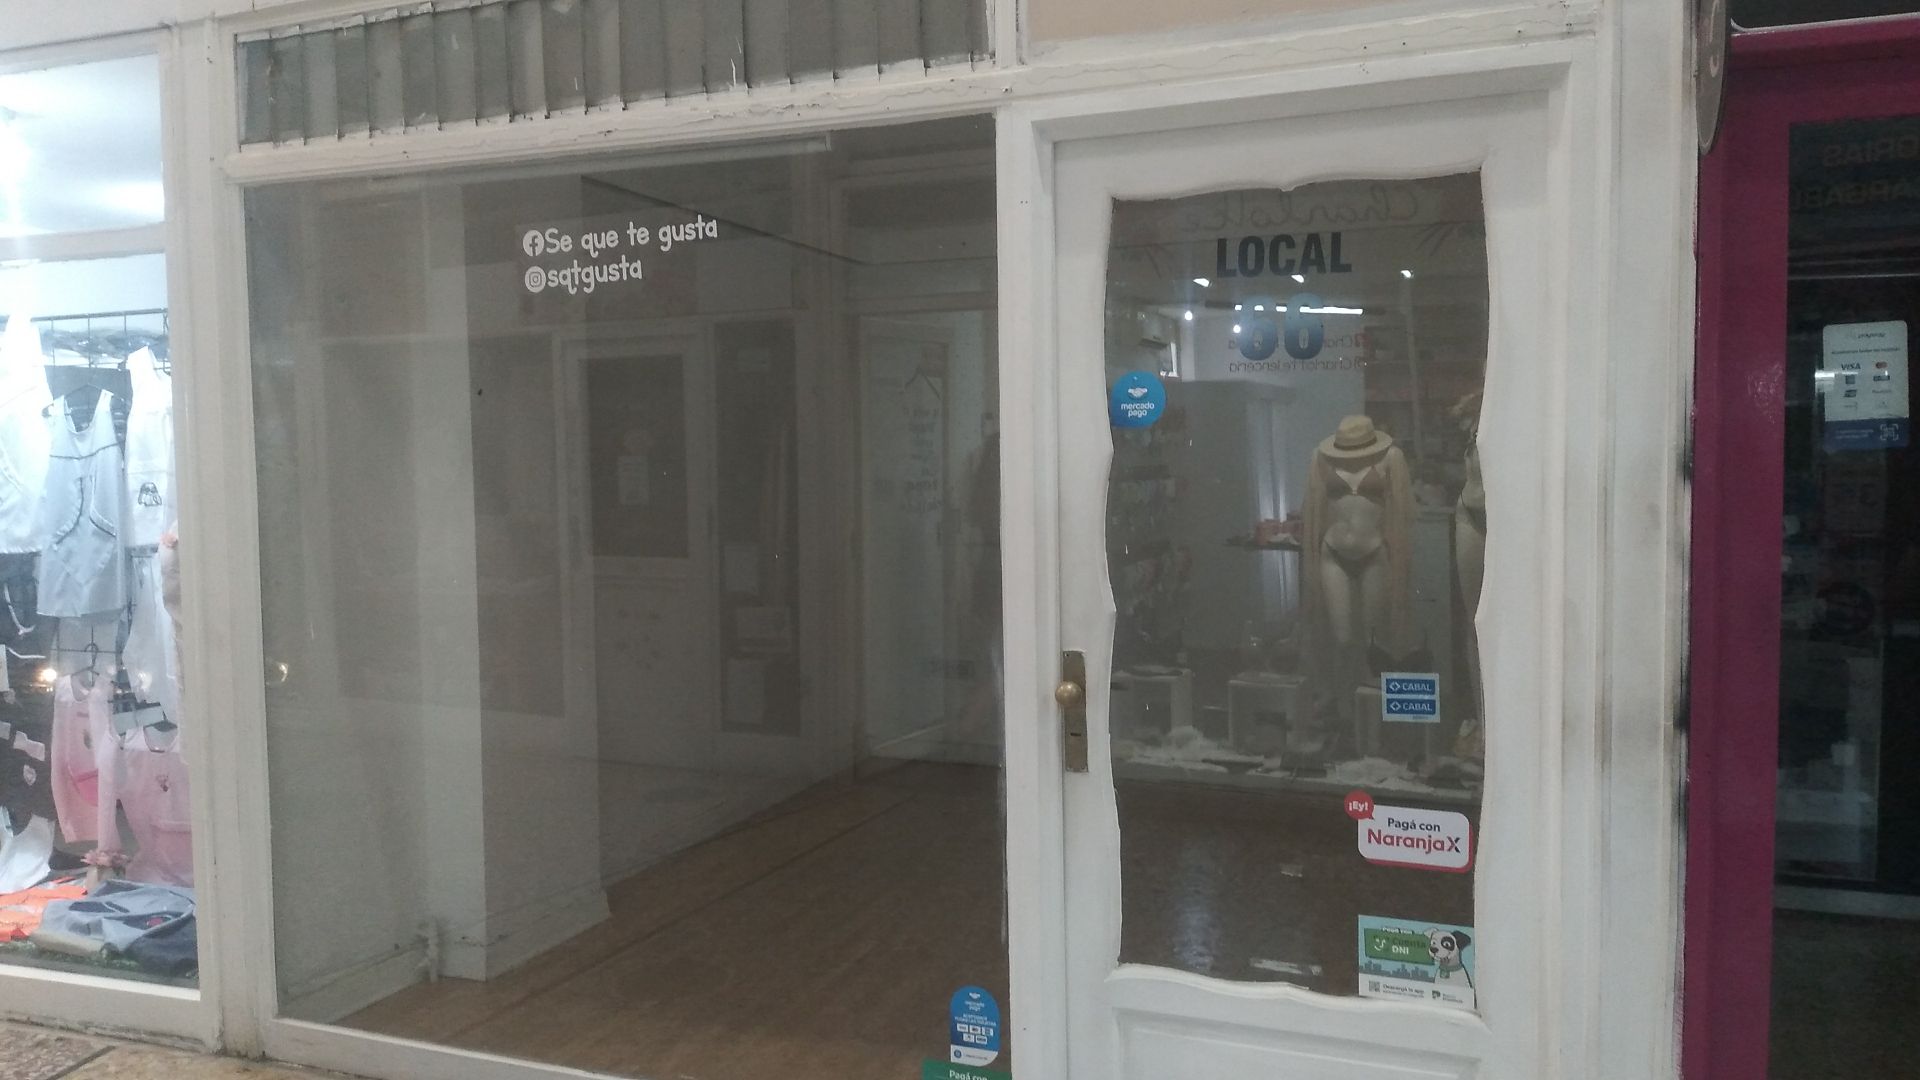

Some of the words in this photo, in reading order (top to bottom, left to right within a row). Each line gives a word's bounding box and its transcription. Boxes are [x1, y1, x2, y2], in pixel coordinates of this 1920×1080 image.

[545, 227, 573, 253] Se
[580, 229, 619, 258] que
[626, 221, 650, 247] te
[658, 214, 718, 252] gusta
[1216, 231, 1352, 278] LOCAL
[1841, 362, 1861, 370] VISA
[1120, 401, 1155, 411] mercado
[1127, 408, 1148, 418] pago
[1402, 682, 1433, 692] CABAL
[1402, 702, 1433, 712] CABAL
[1348, 800, 1369, 812] ¡Ey!
[1387, 817, 1417, 831] Pagá
[1418, 822, 1441, 832] con
[1391, 945, 1409, 955] DNI
